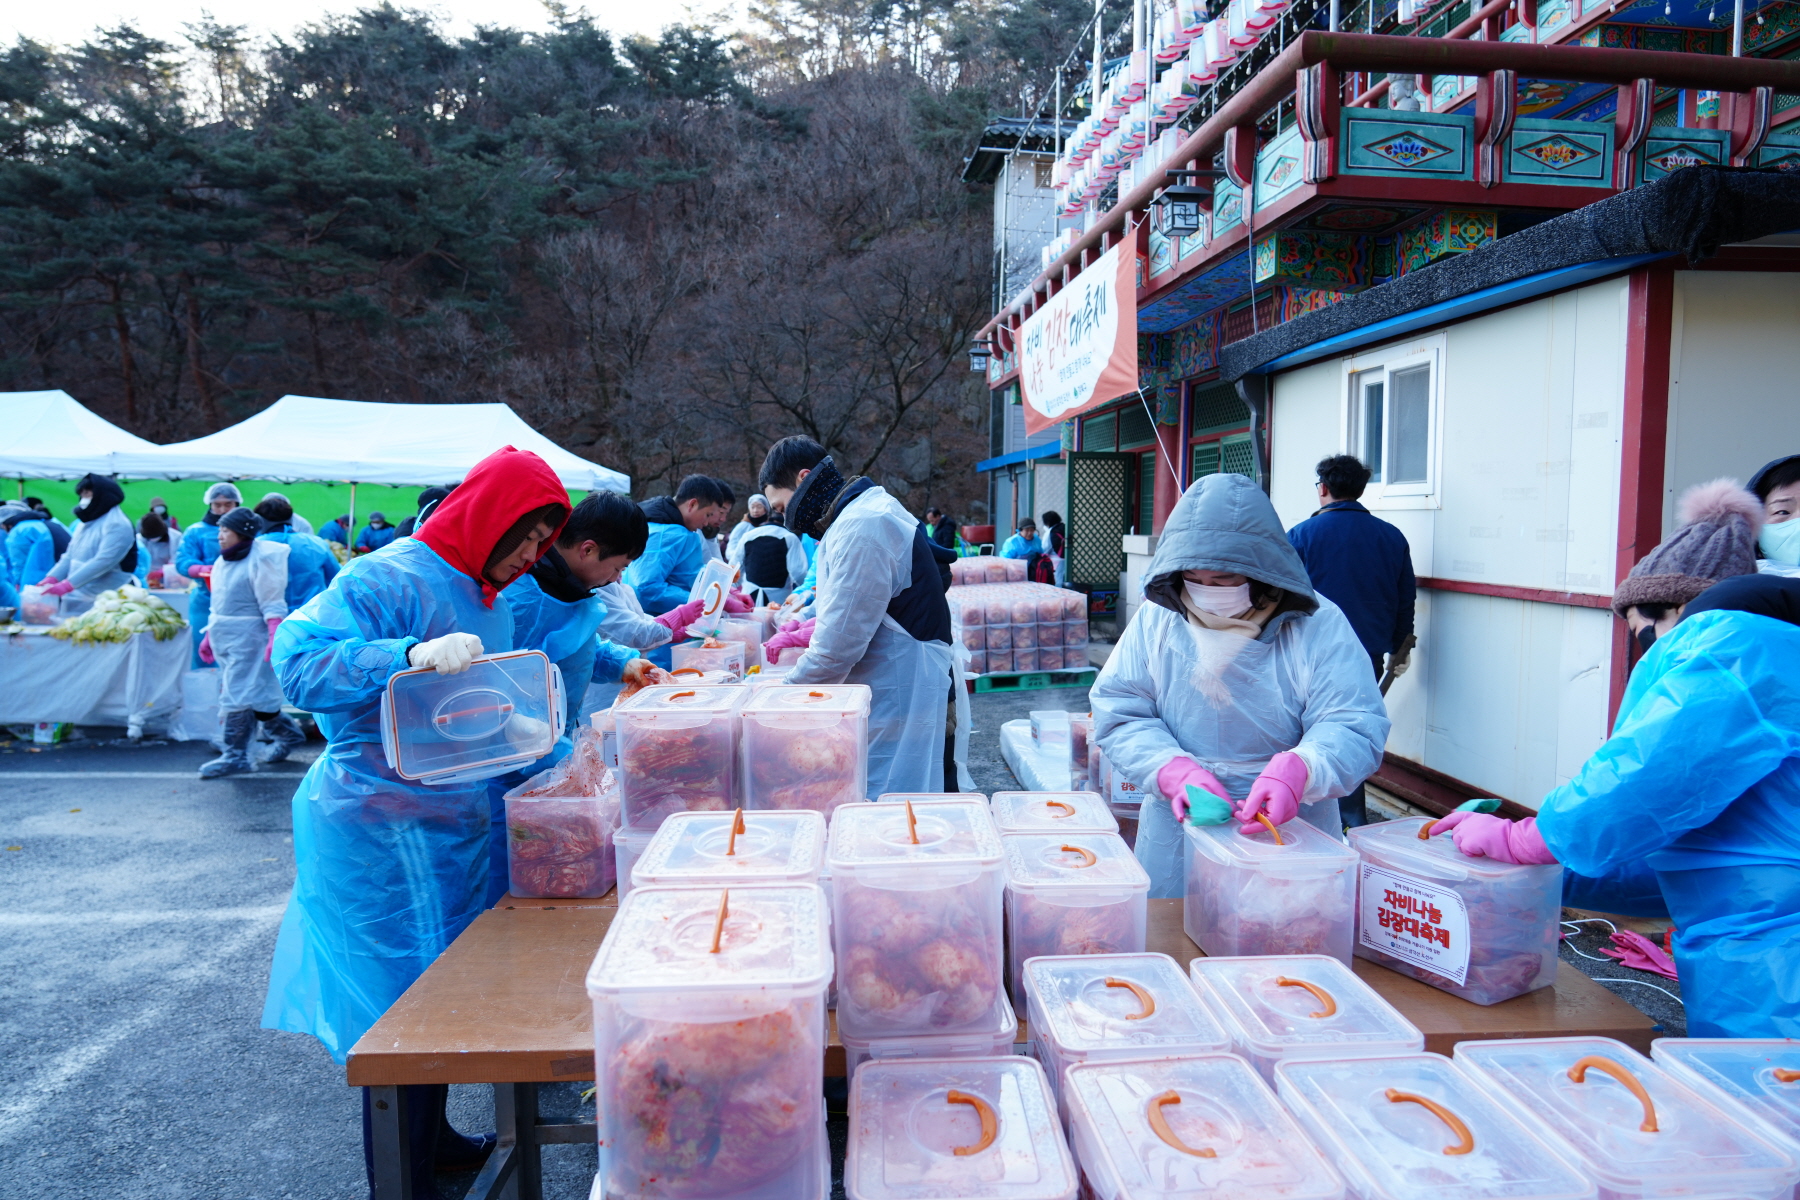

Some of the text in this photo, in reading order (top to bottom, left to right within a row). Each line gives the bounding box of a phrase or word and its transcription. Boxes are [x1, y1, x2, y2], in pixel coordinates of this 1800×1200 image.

[1026, 280, 1106, 371] 자비 김장 대축제
[1377, 906, 1450, 950] 김장대축제
[1384, 889, 1443, 925] 자비나눔
